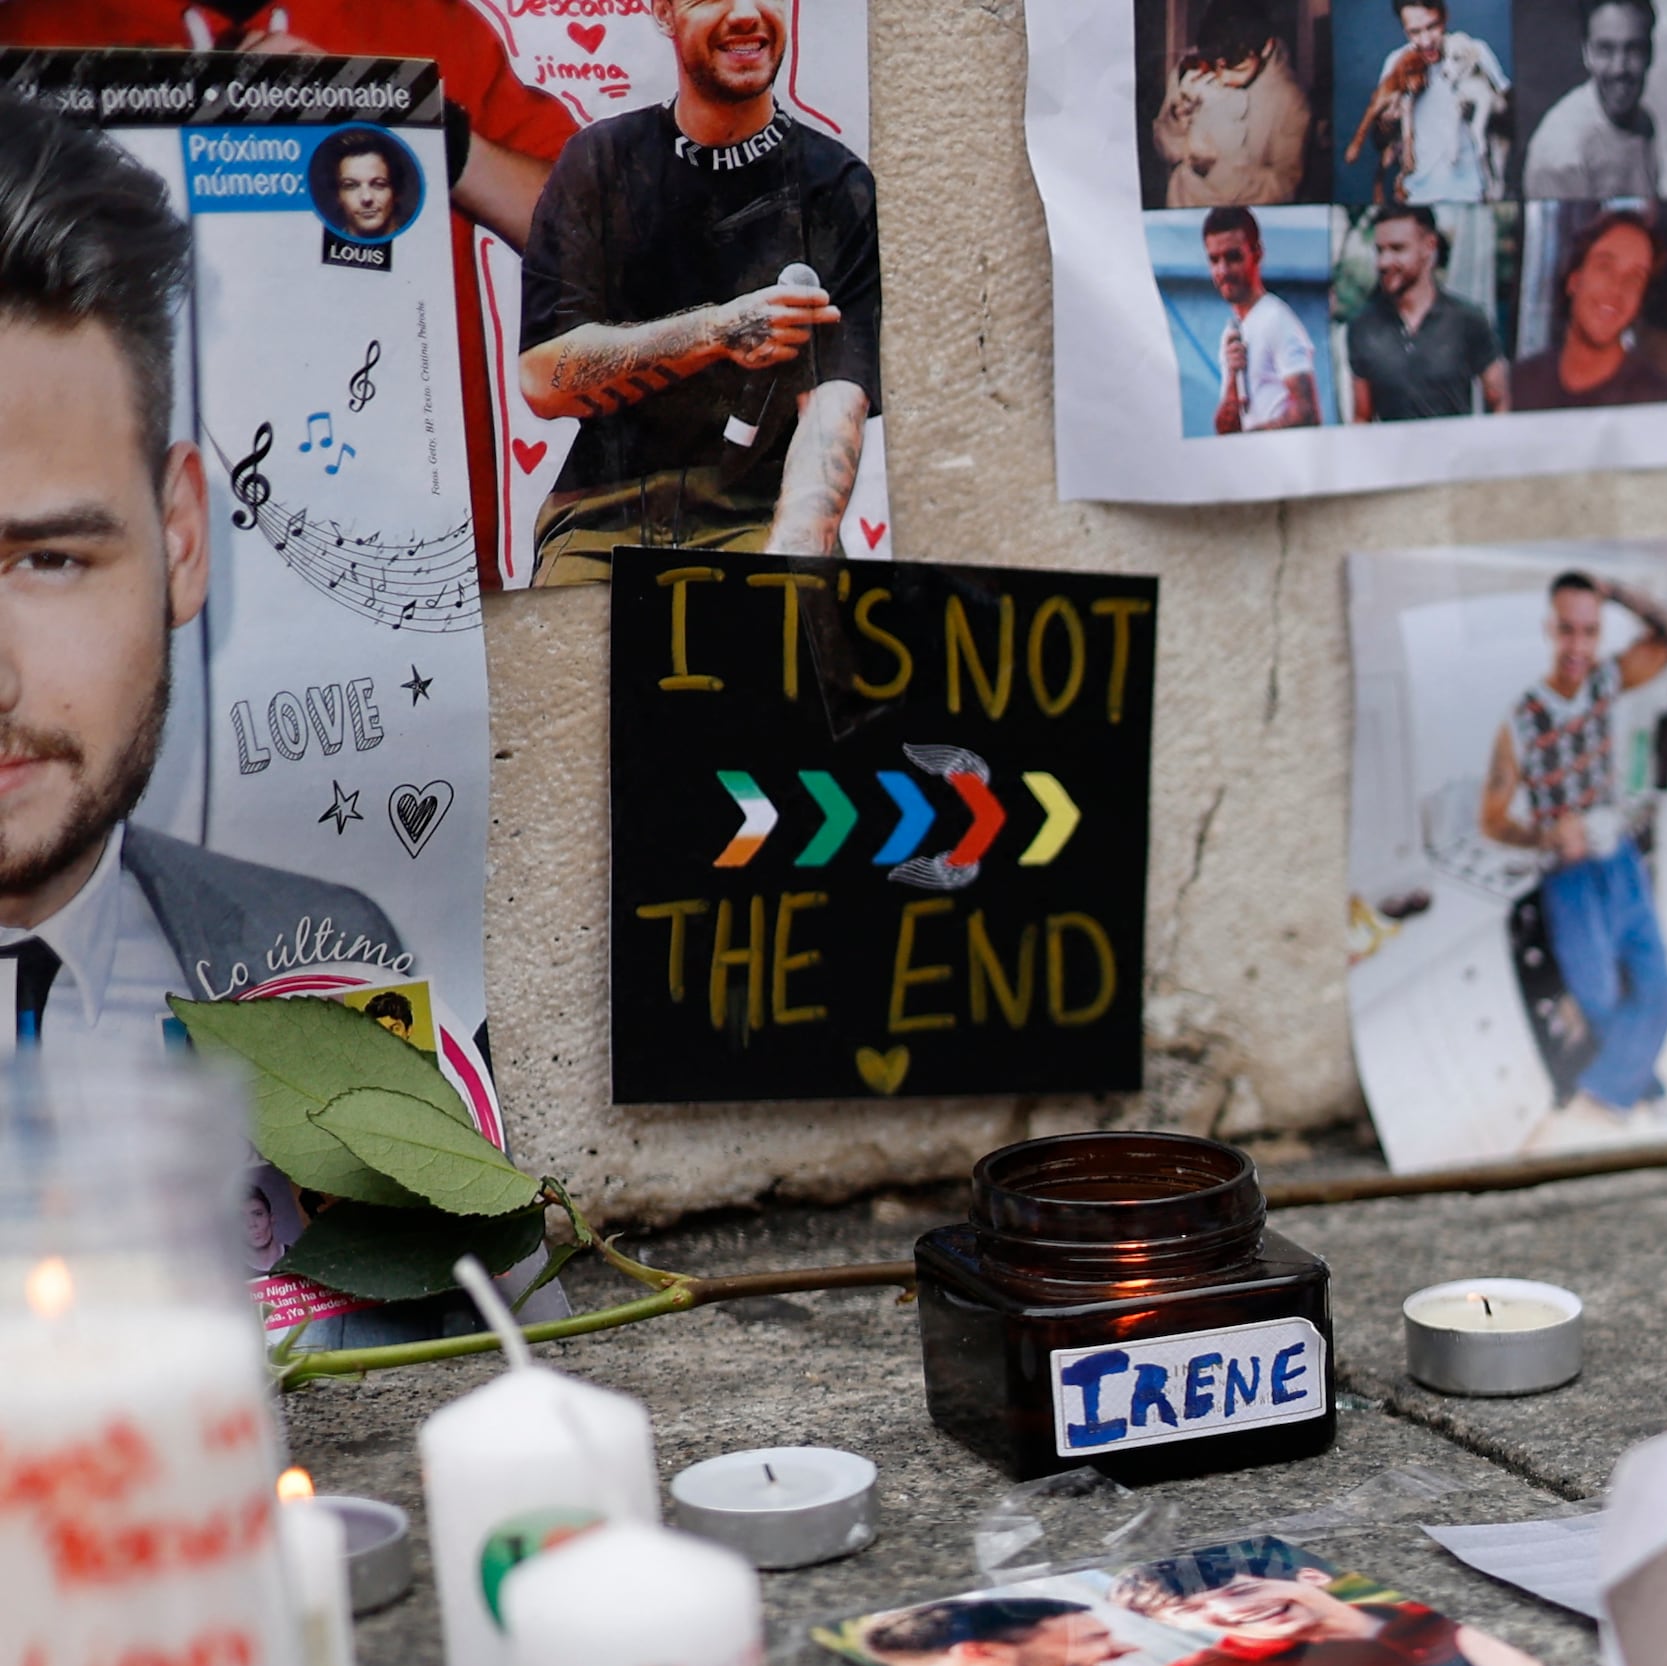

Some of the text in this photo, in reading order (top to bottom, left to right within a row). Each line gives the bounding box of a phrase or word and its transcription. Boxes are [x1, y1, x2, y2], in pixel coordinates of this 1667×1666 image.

[101, 79, 195, 115] pronto!
[226, 80, 410, 109] Coleccionable
[189, 133, 300, 163] Próximo
[712, 124, 784, 171] HUGO
[194, 168, 305, 198] número:
[330, 245, 385, 265] LOUIS
[656, 567, 1151, 724] IT'S NOT
[230, 677, 384, 775] LOVE
[197, 916, 415, 1000] Lo último
[635, 892, 1118, 1033] THE END
[266, 1282, 297, 1297] Night
[302, 1292, 317, 1303] ha
[1061, 1342, 1309, 1449] IRENE
